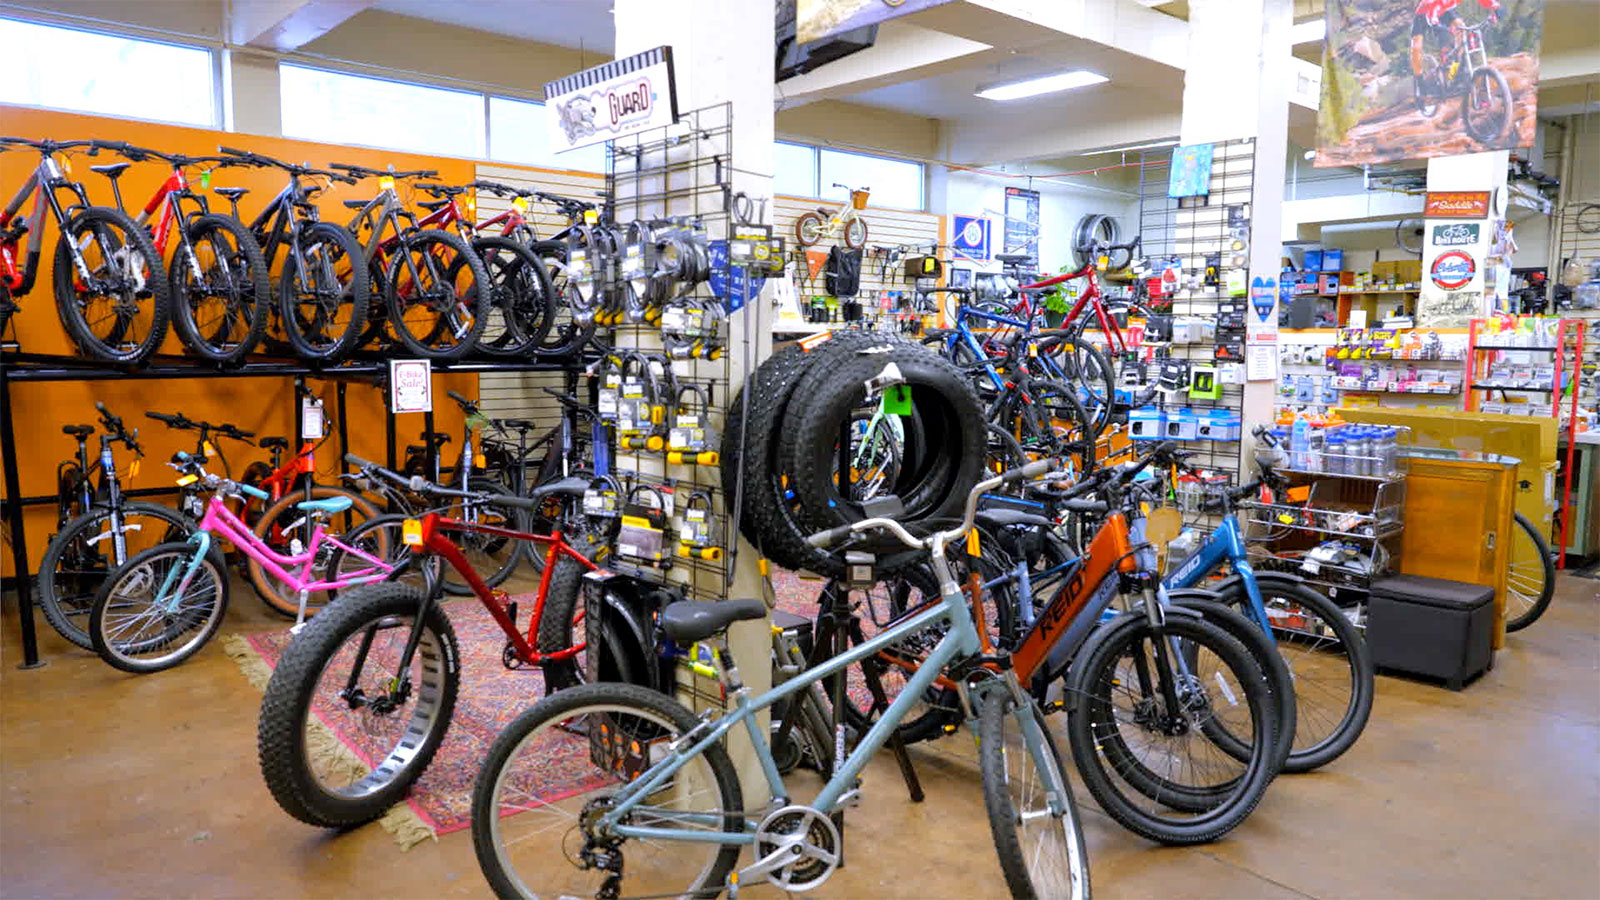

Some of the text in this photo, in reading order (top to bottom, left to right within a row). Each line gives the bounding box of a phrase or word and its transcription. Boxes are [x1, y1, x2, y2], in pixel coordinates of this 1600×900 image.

[608, 83, 649, 125] GUARD
[1451, 234, 1476, 244] ROUTE
[1170, 554, 1200, 589] REID
[1039, 576, 1083, 640] REID
